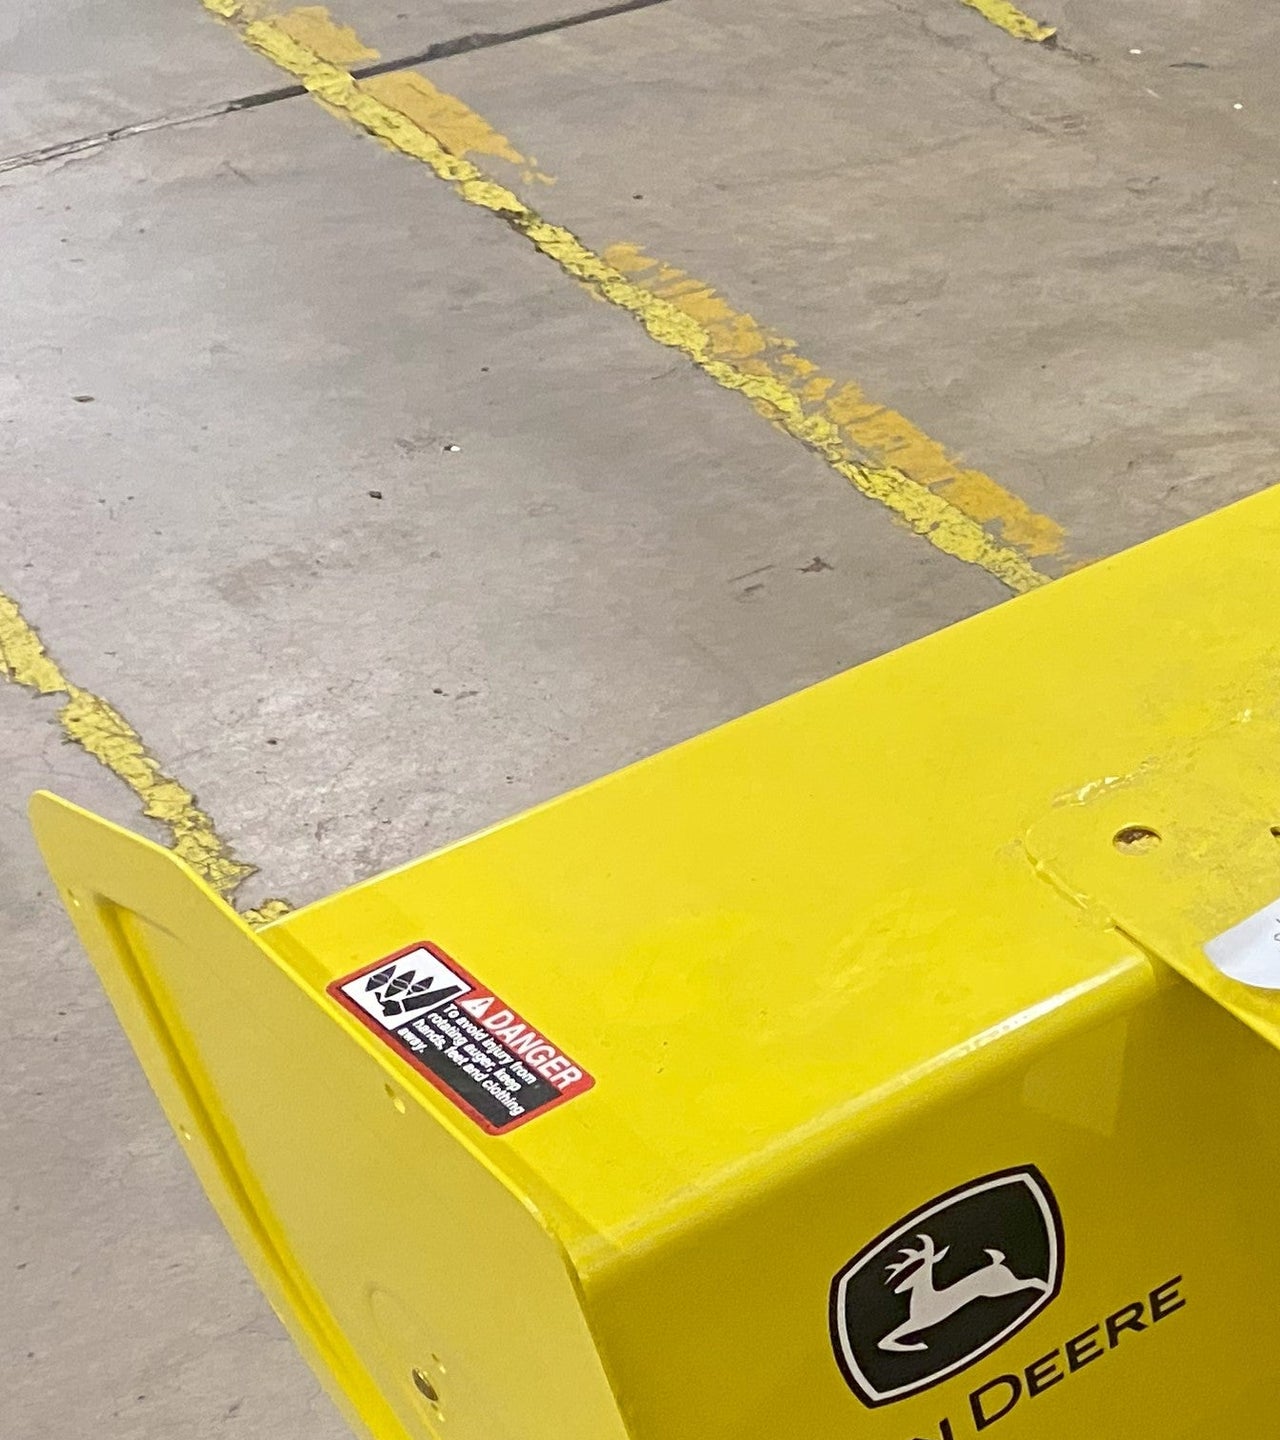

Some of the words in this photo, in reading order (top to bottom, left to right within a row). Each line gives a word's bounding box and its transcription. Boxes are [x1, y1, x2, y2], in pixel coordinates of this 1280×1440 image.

[397, 1026, 428, 1054] away.
[412, 1018, 447, 1051] hands,
[448, 1045, 466, 1067] feet
[463, 1061, 484, 1083] and
[481, 1076, 526, 1117] clothing
[427, 1012, 468, 1047] rotating
[463, 1042, 497, 1073] auger,
[494, 1063, 522, 1092] keep
[443, 1003, 460, 1020] To
[455, 1011, 486, 1041] avoid
[482, 1035, 513, 1070] injury
[509, 1055, 537, 1085] from
[482, 1010, 583, 1090] DANGER
[969, 1275, 1187, 1431] DEERE
